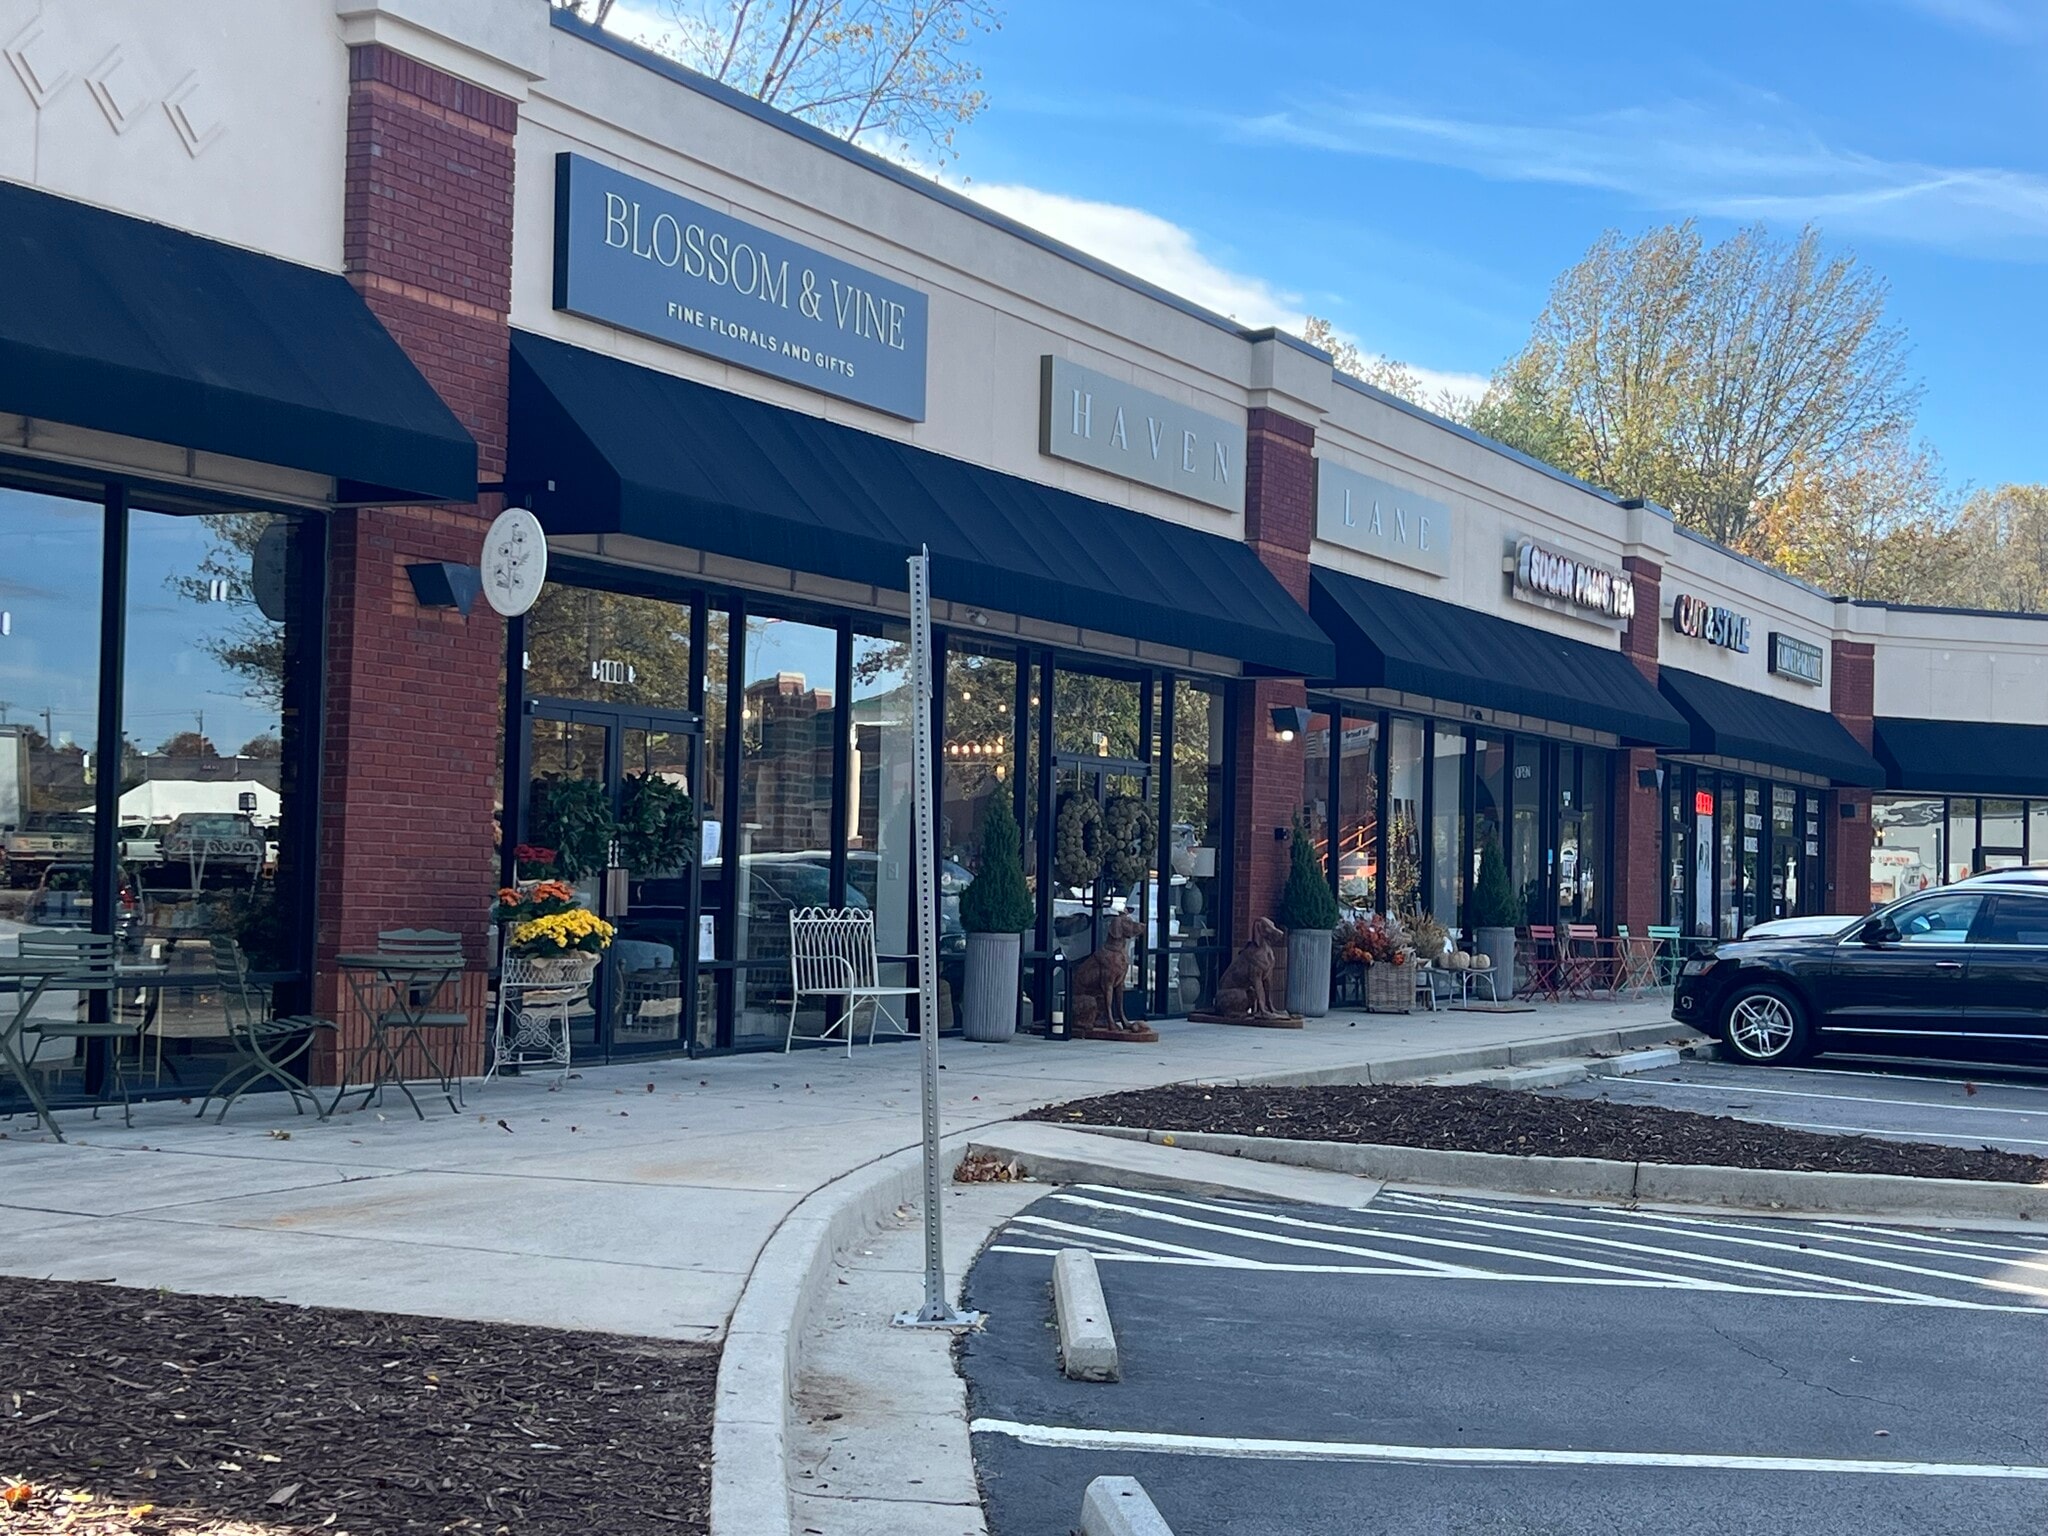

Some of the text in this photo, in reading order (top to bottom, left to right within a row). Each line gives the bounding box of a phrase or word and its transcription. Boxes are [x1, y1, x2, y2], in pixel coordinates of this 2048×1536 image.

[604, 191, 906, 351] BLOSSOM & VINE
[667, 302, 855, 377] FINE FLORALS AND GIFTS
[1072, 389, 1229, 484] HAVEN
[1344, 488, 1430, 551] LANE
[1530, 546, 1635, 619] SUGAR PAWS TEA
[1677, 594, 1706, 638] CUT
[1705, 606, 1715, 640] &
[1715, 607, 1750, 653] STYLE
[602, 661, 622, 682] 100
[1514, 765, 1531, 779] OPEN
